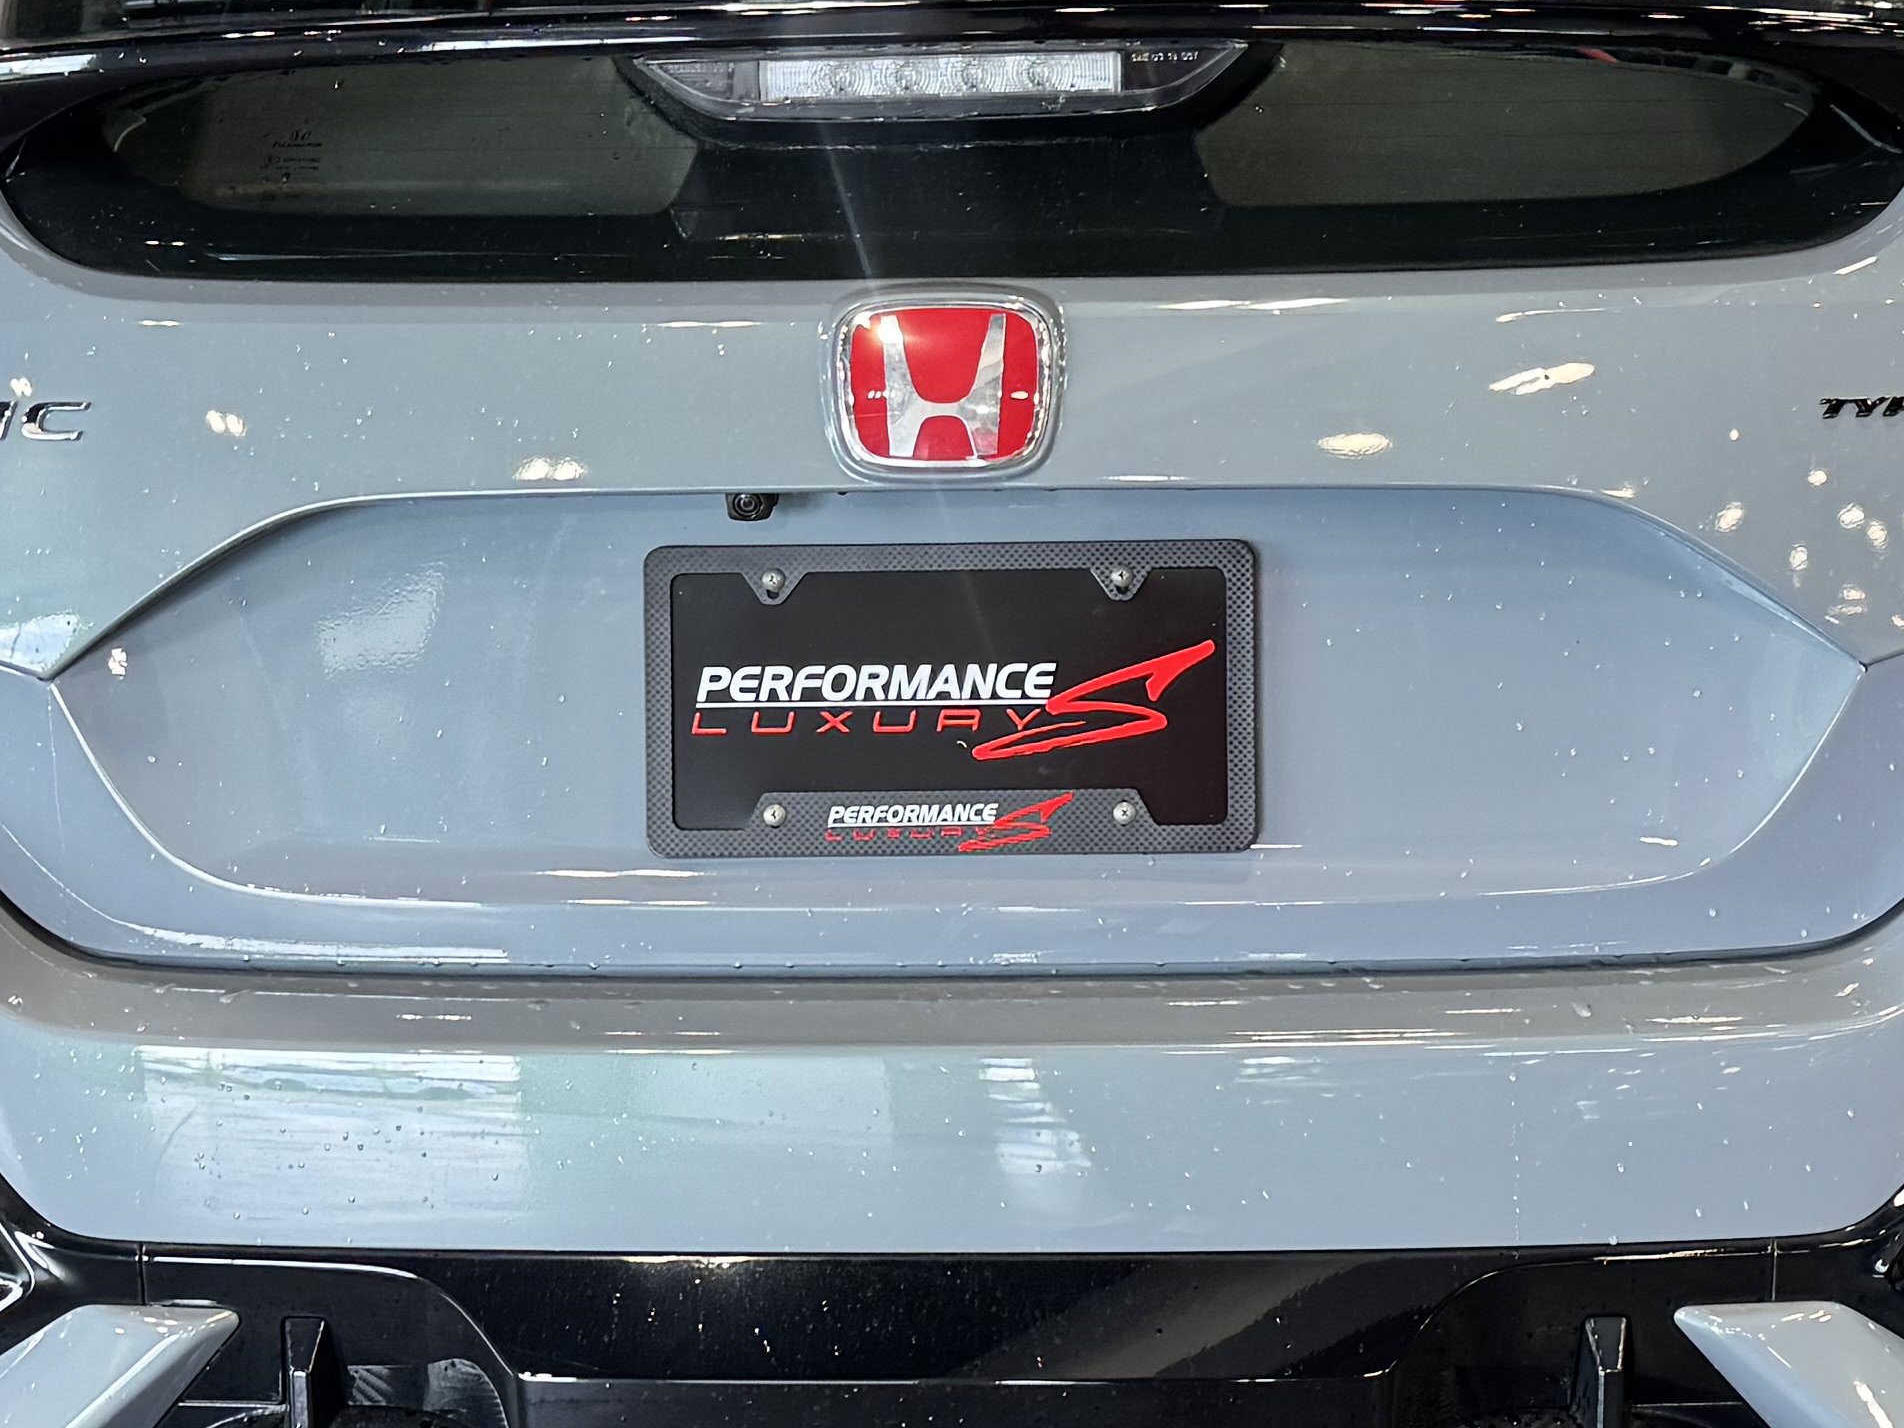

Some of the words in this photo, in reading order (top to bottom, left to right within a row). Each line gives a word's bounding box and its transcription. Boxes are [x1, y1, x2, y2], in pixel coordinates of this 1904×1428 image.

[696, 662, 1057, 704] PERFORMANCE
[691, 707, 1042, 735] LUXURY
[827, 803, 999, 825] PERFORMANCE
